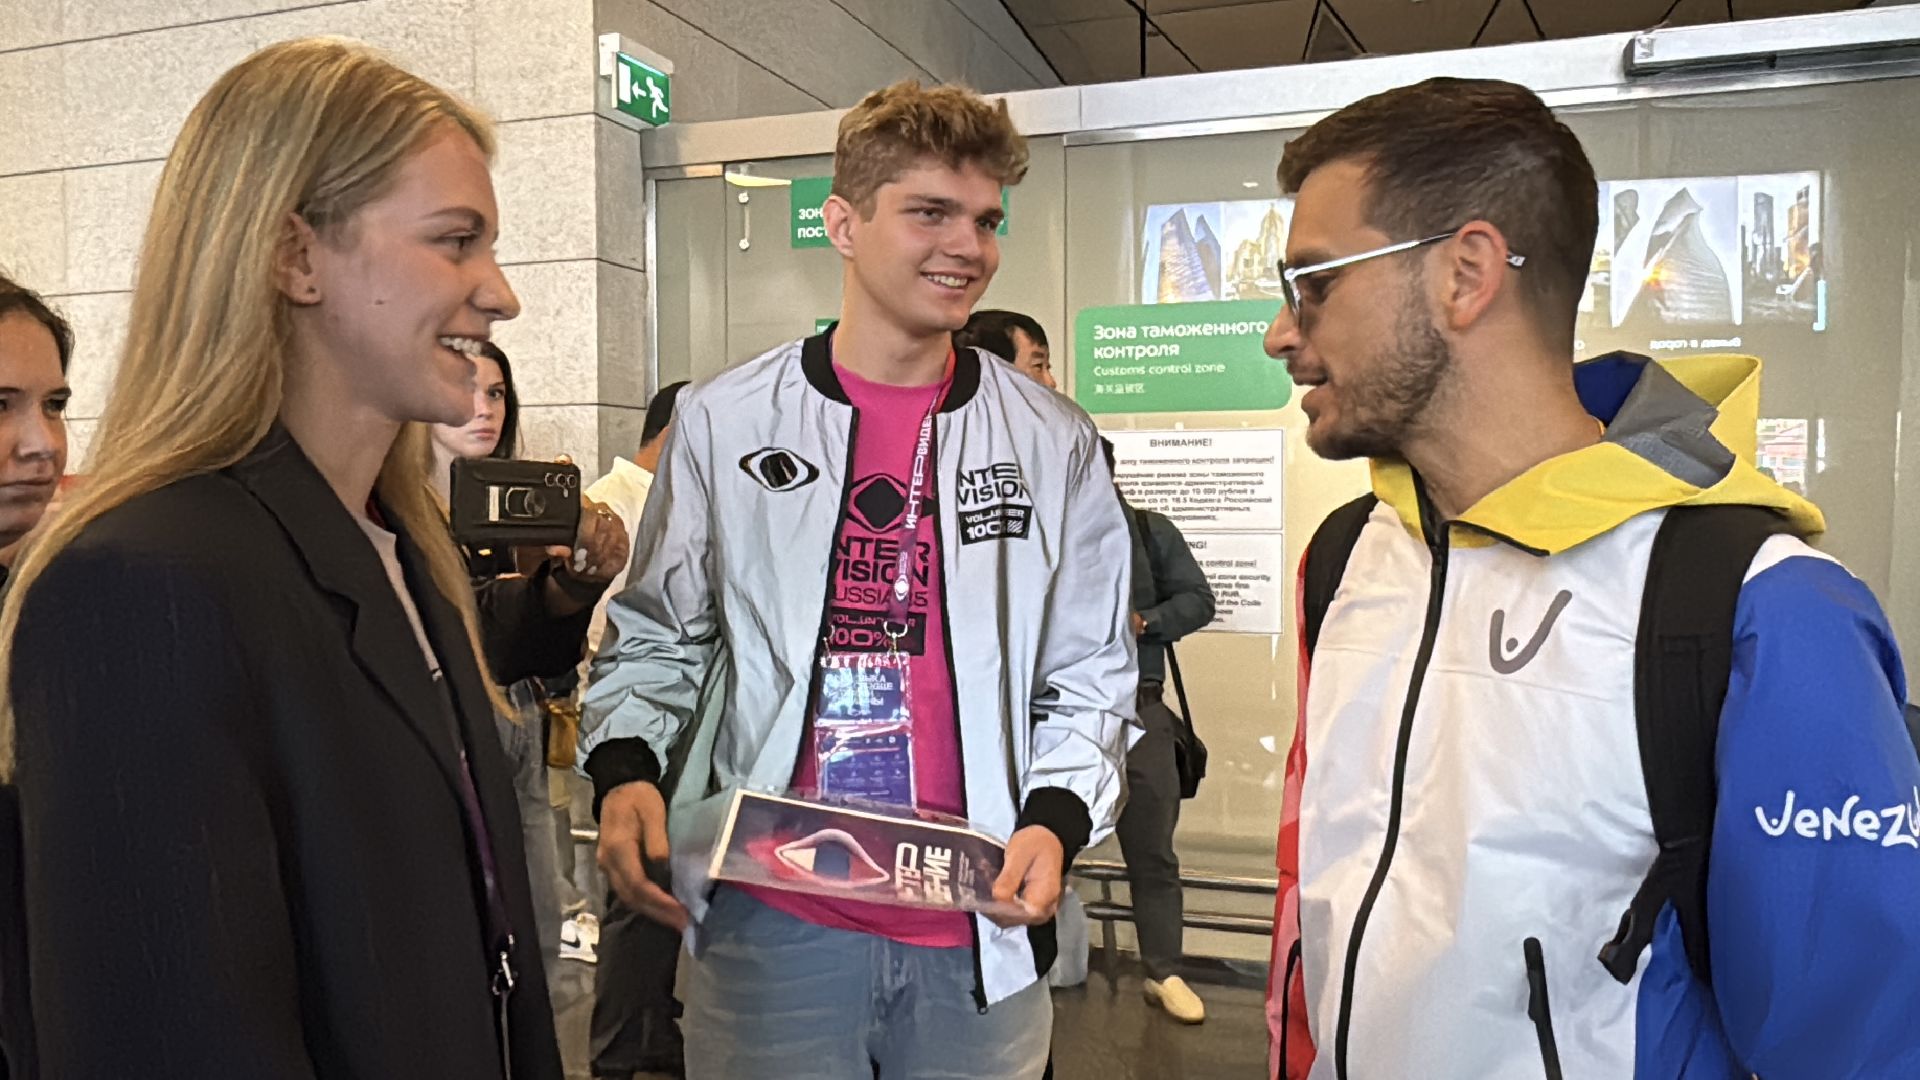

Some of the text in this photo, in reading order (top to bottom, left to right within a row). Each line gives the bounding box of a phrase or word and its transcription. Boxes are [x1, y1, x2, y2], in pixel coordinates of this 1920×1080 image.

[798, 207, 824, 220] ЗОН
[1093, 320, 1269, 340] Зона таможенного
[1093, 344, 1180, 361] контроля
[1093, 363, 1226, 377] Customs control zone
[1150, 438, 1212, 447] ВНИМАНИЕ!
